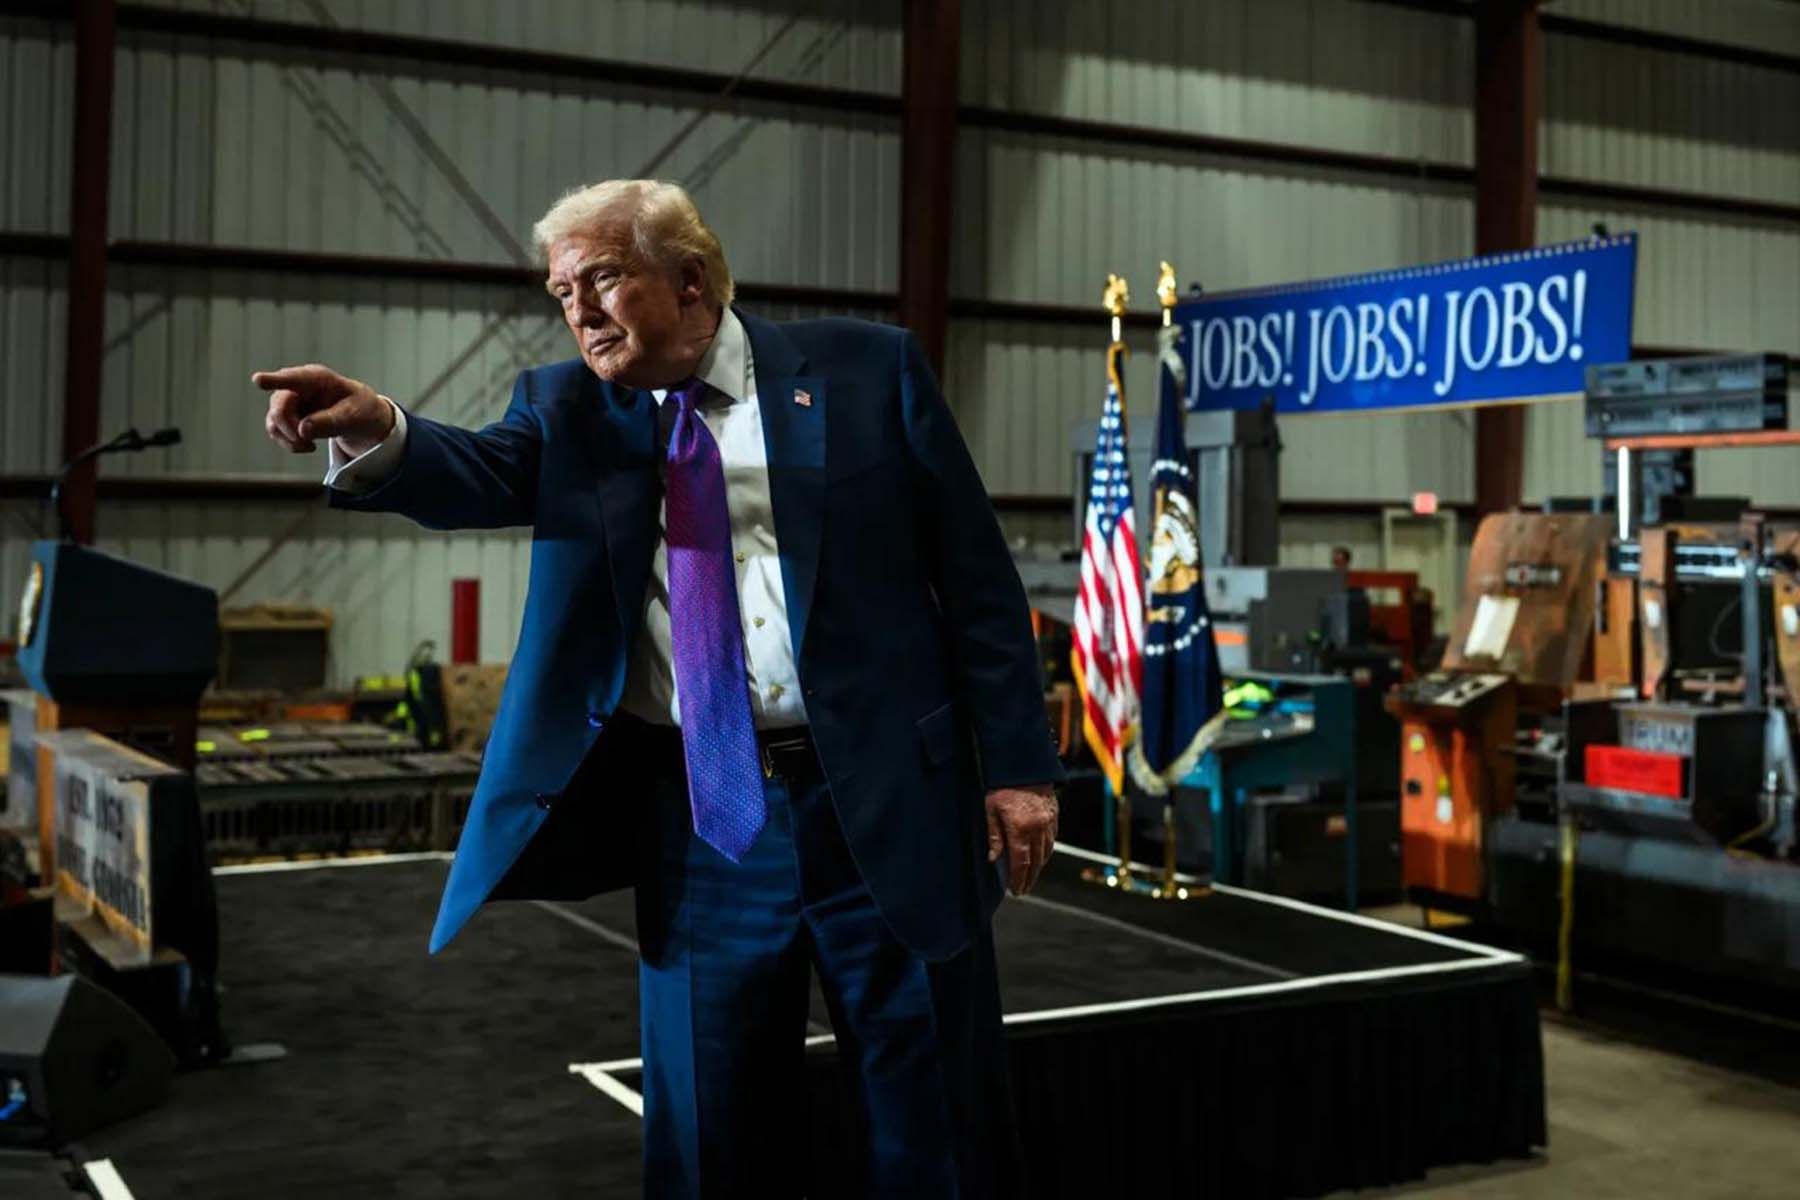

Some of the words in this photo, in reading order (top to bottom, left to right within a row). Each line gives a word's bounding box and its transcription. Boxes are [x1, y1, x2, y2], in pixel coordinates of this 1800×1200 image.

[1184, 309, 1295, 409] JOBS!
[1300, 293, 1430, 405] JOBS!
[1433, 269, 1587, 397] JOBS!
